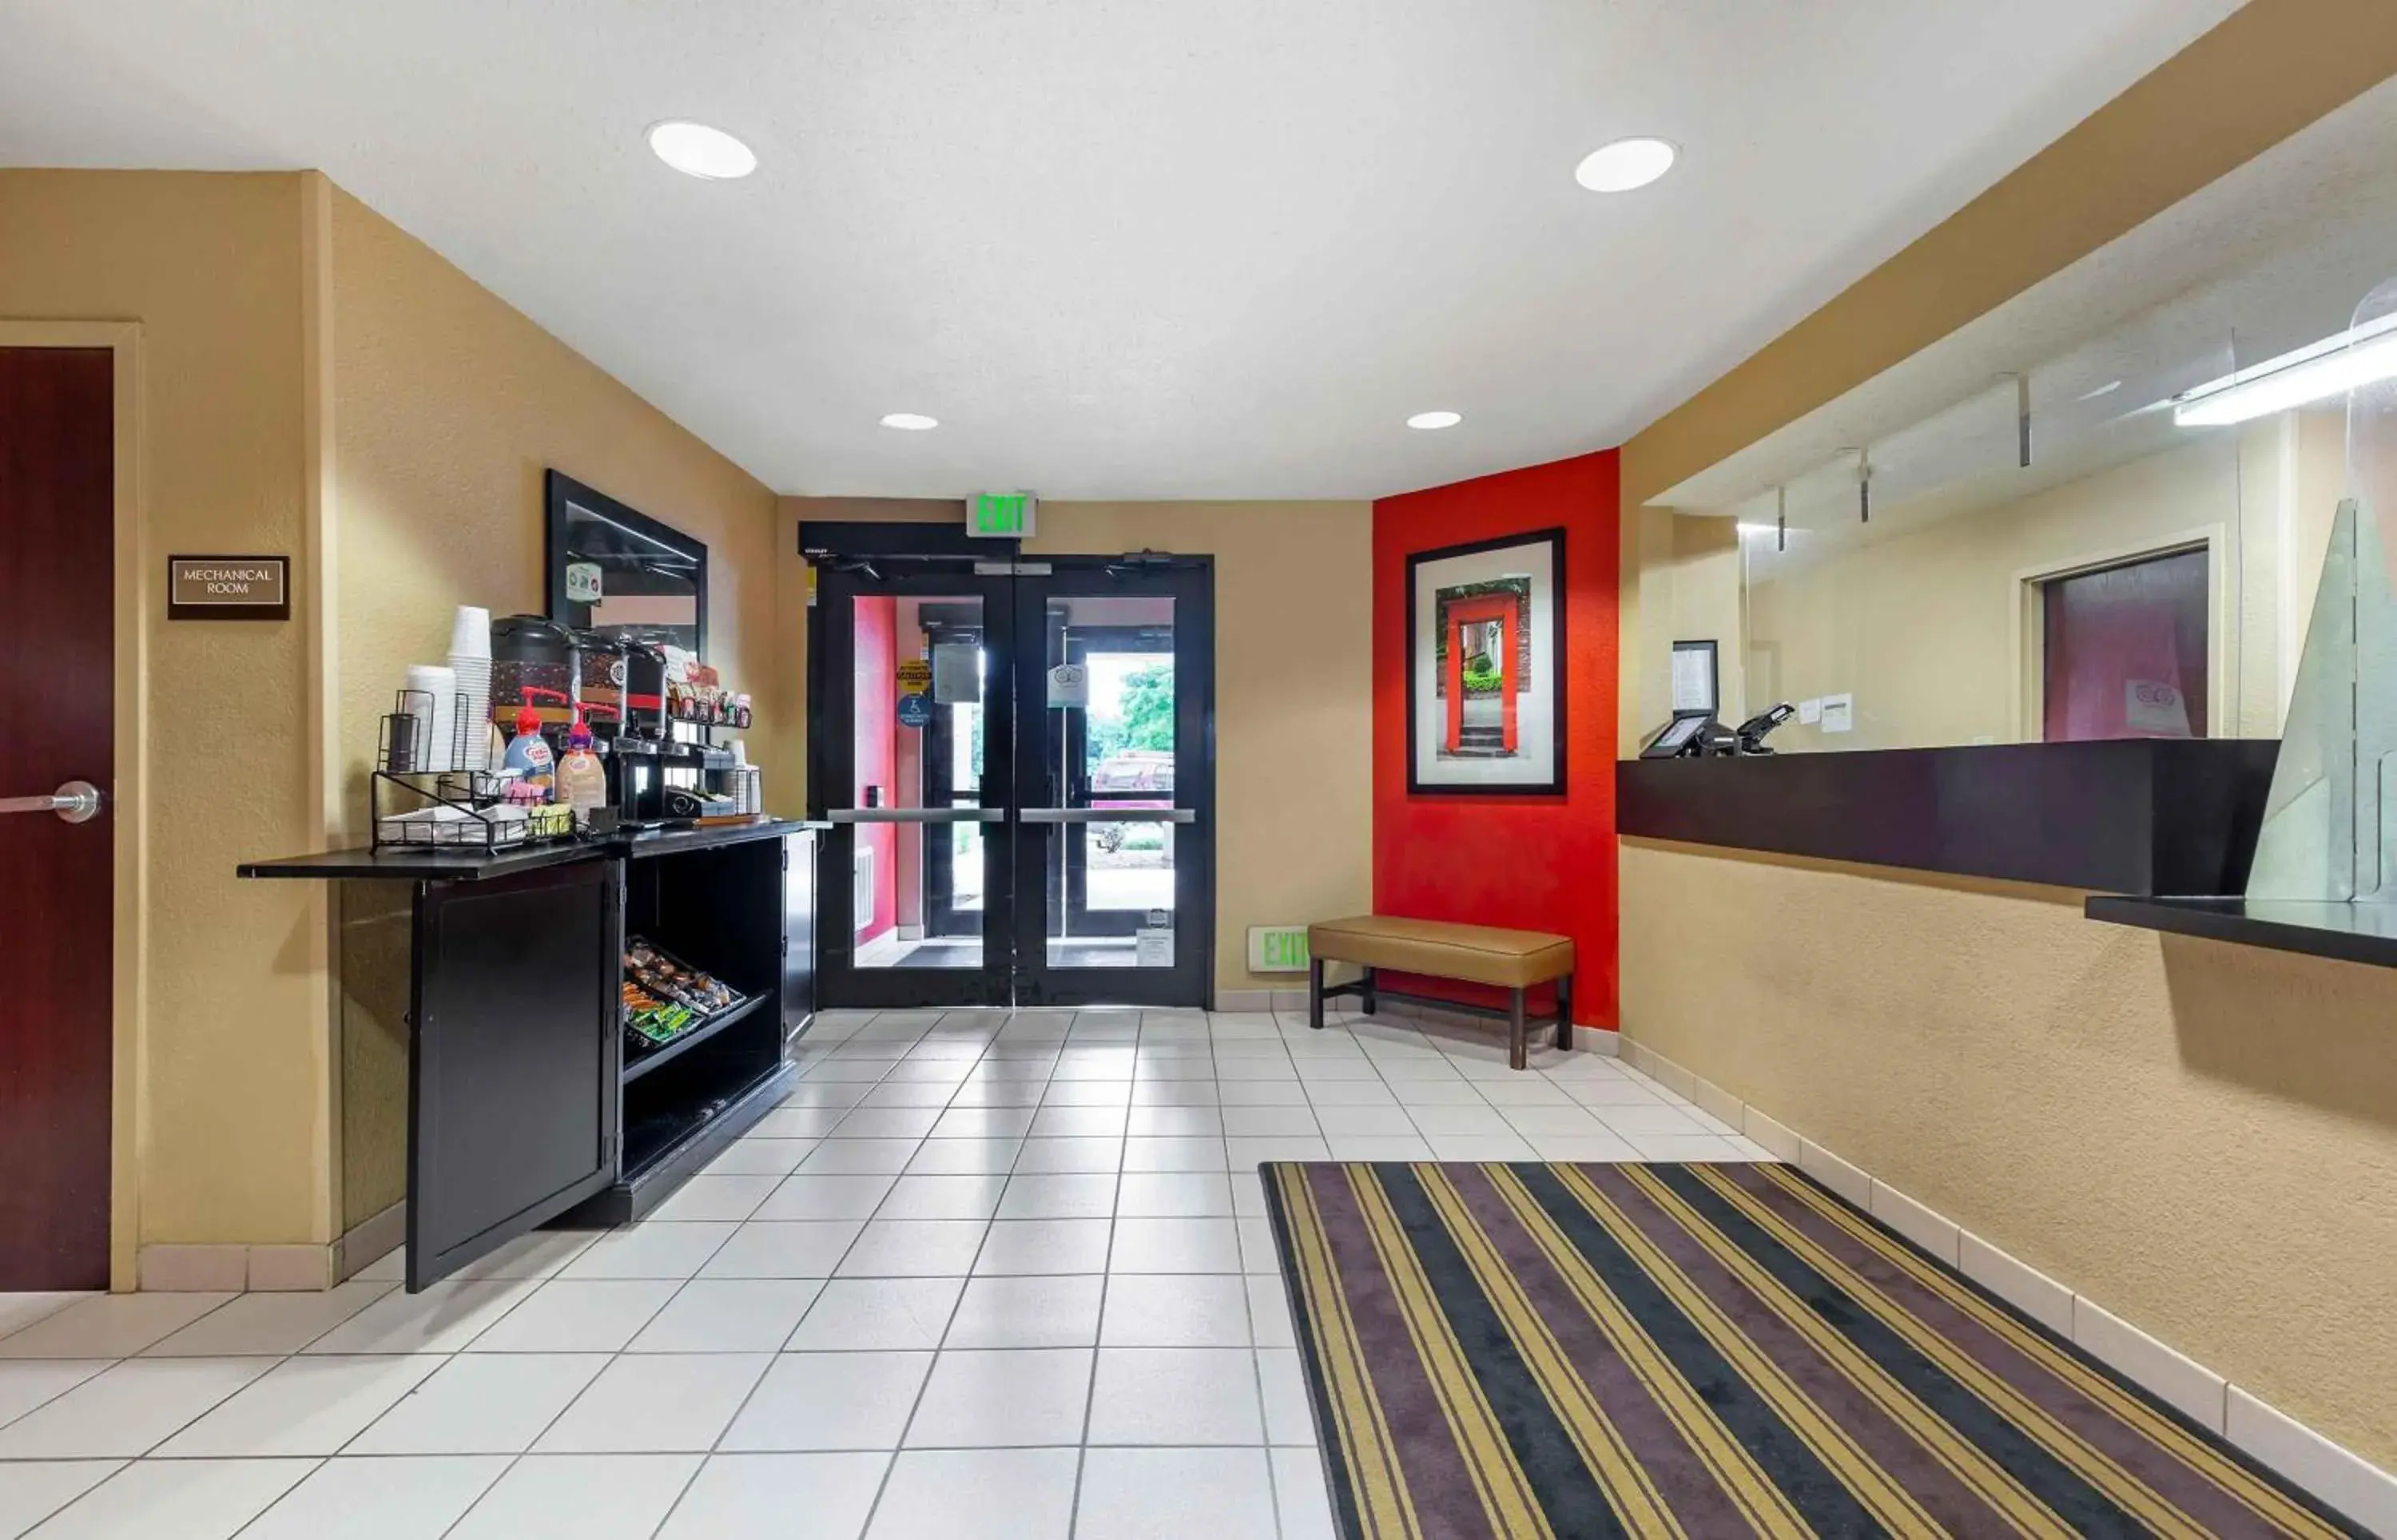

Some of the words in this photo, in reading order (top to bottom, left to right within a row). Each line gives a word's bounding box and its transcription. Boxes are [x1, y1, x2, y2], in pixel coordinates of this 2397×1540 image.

[977, 494, 1027, 533] EXIT
[183, 570, 272, 581] MECHANICAL
[206, 582, 249, 593] ROOM
